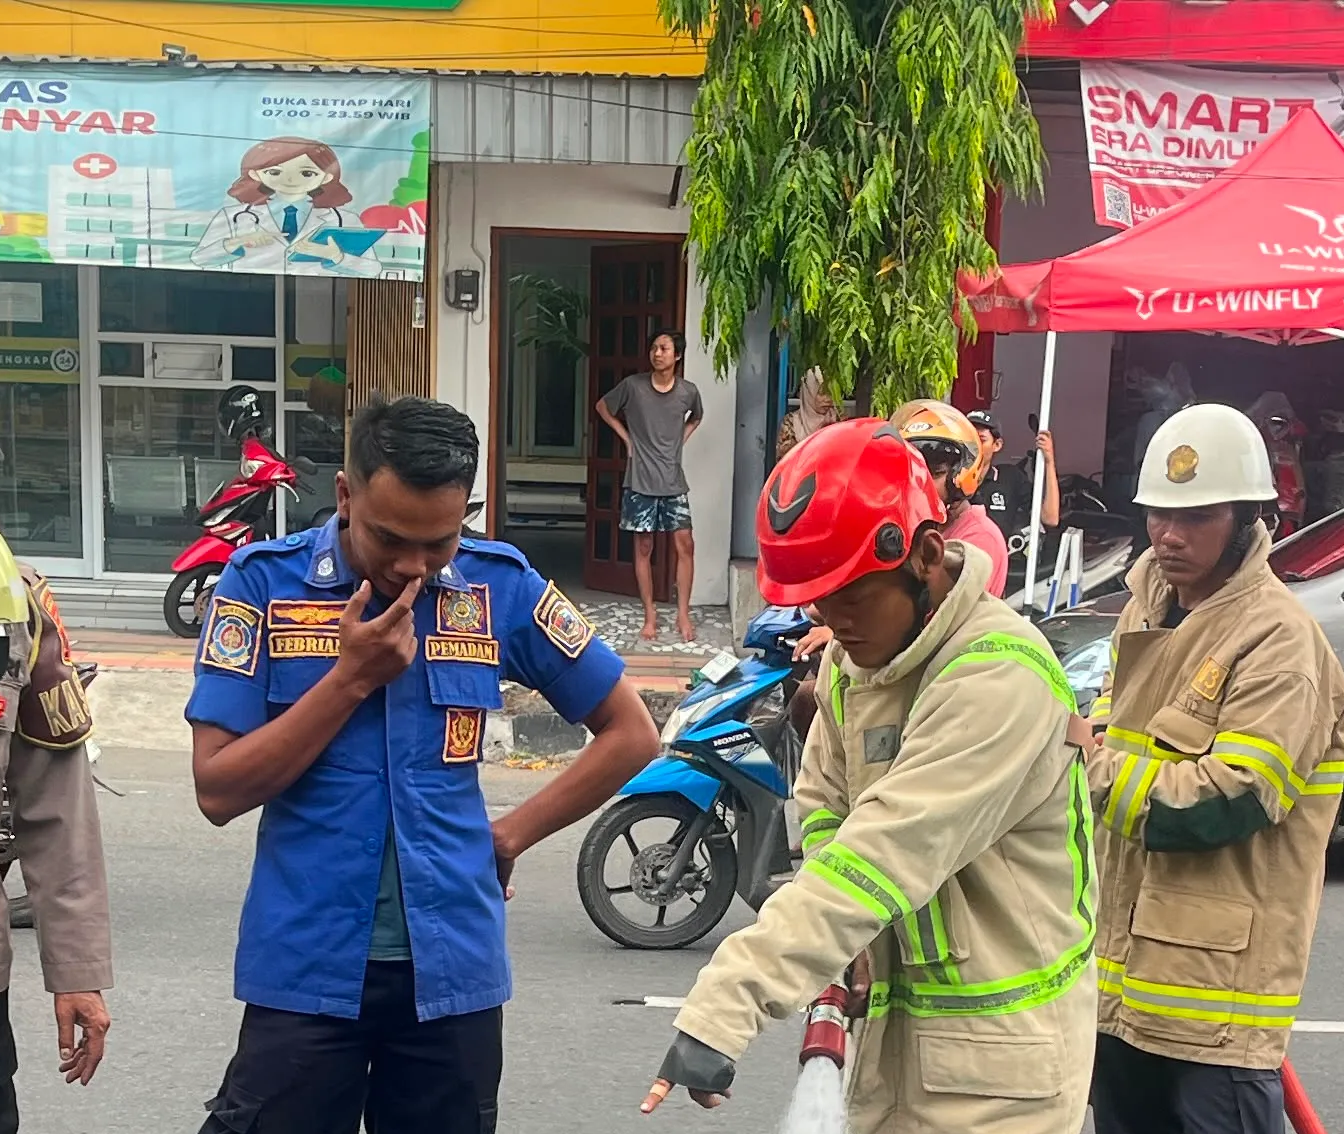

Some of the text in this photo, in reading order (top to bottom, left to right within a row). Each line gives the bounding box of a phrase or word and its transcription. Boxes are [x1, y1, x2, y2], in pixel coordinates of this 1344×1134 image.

[261, 96, 411, 108] BUKA SETIAP HARI
[1087, 84, 1316, 135] SMART
[262, 108, 311, 118] 07.00
[327, 109, 374, 119] 23.59
[377, 111, 411, 121] WIB
[1092, 126, 1153, 154] ERA
[429, 640, 494, 660] PEMADAM
[712, 731, 752, 747] HONDA
